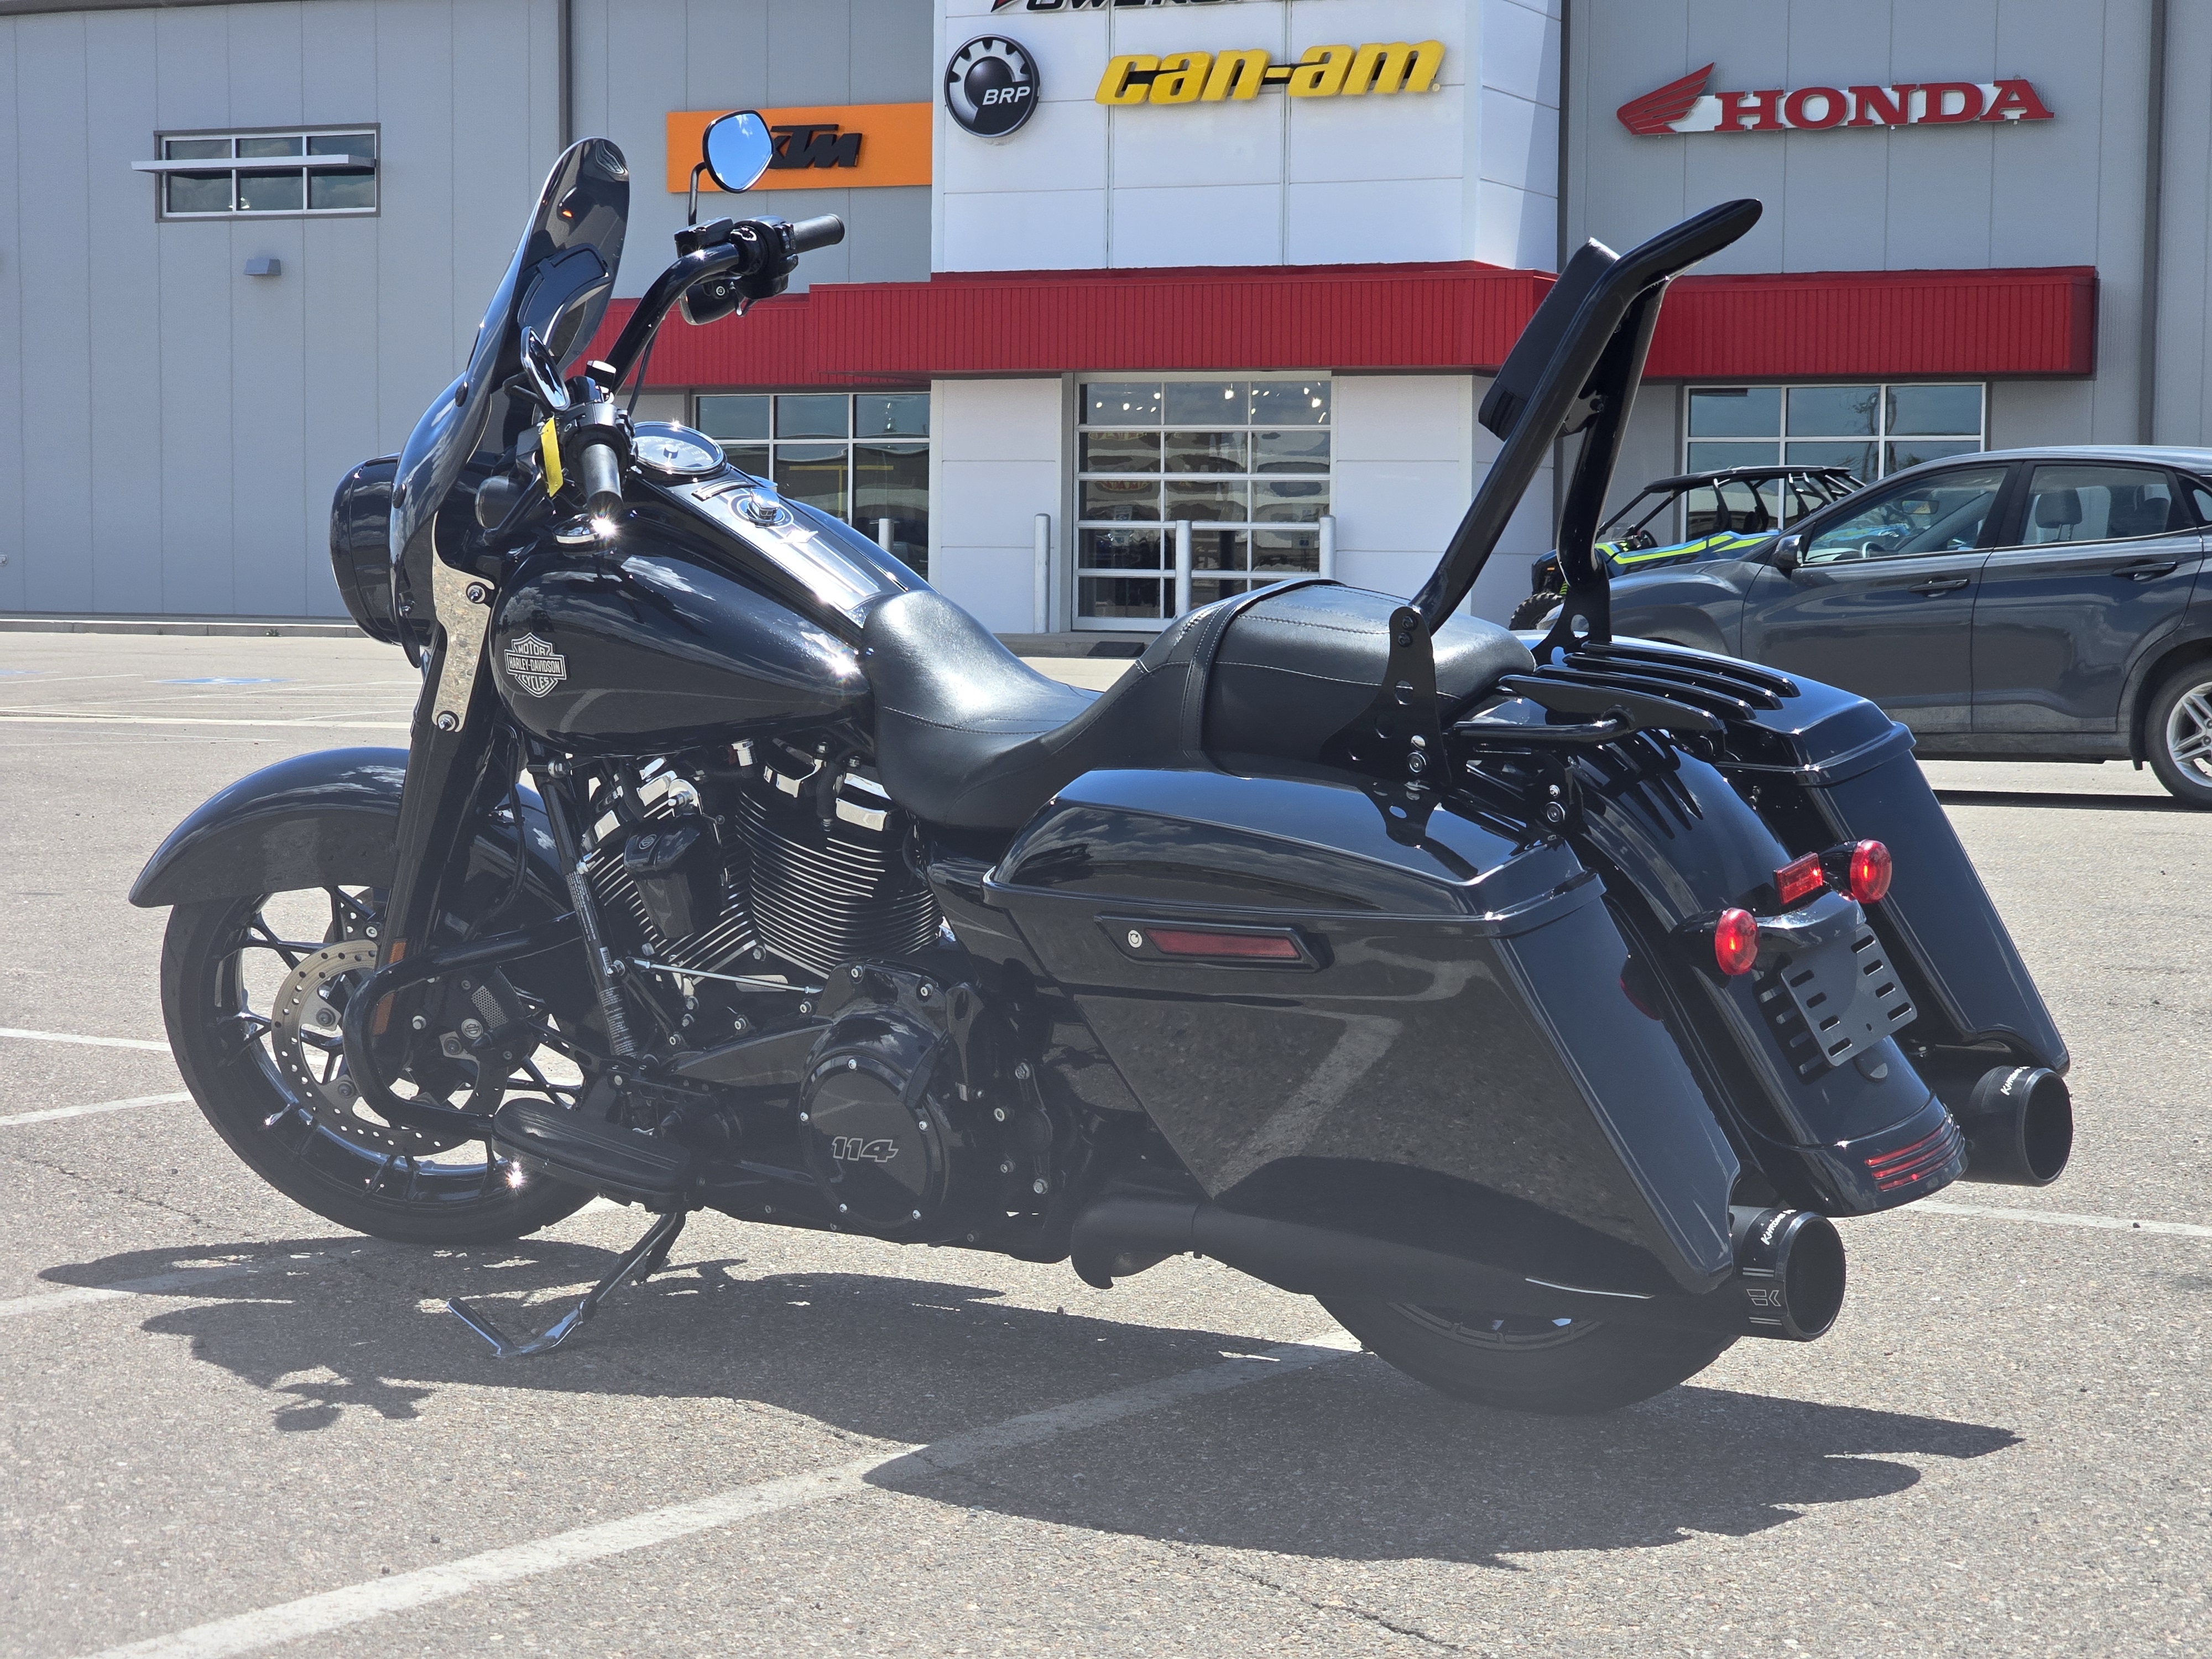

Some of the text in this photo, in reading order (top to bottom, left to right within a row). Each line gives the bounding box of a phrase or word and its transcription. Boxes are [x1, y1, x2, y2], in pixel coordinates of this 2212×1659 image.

[1095, 40, 1445, 105] can-am
[982, 86, 1030, 106] BRP
[1715, 79, 2056, 131] HONDA
[518, 640, 546, 655] MOTOR
[509, 656, 561, 673] HARLEY-DAVIDSON
[521, 674, 550, 691] CYCLES
[832, 1136, 899, 1162] 114
